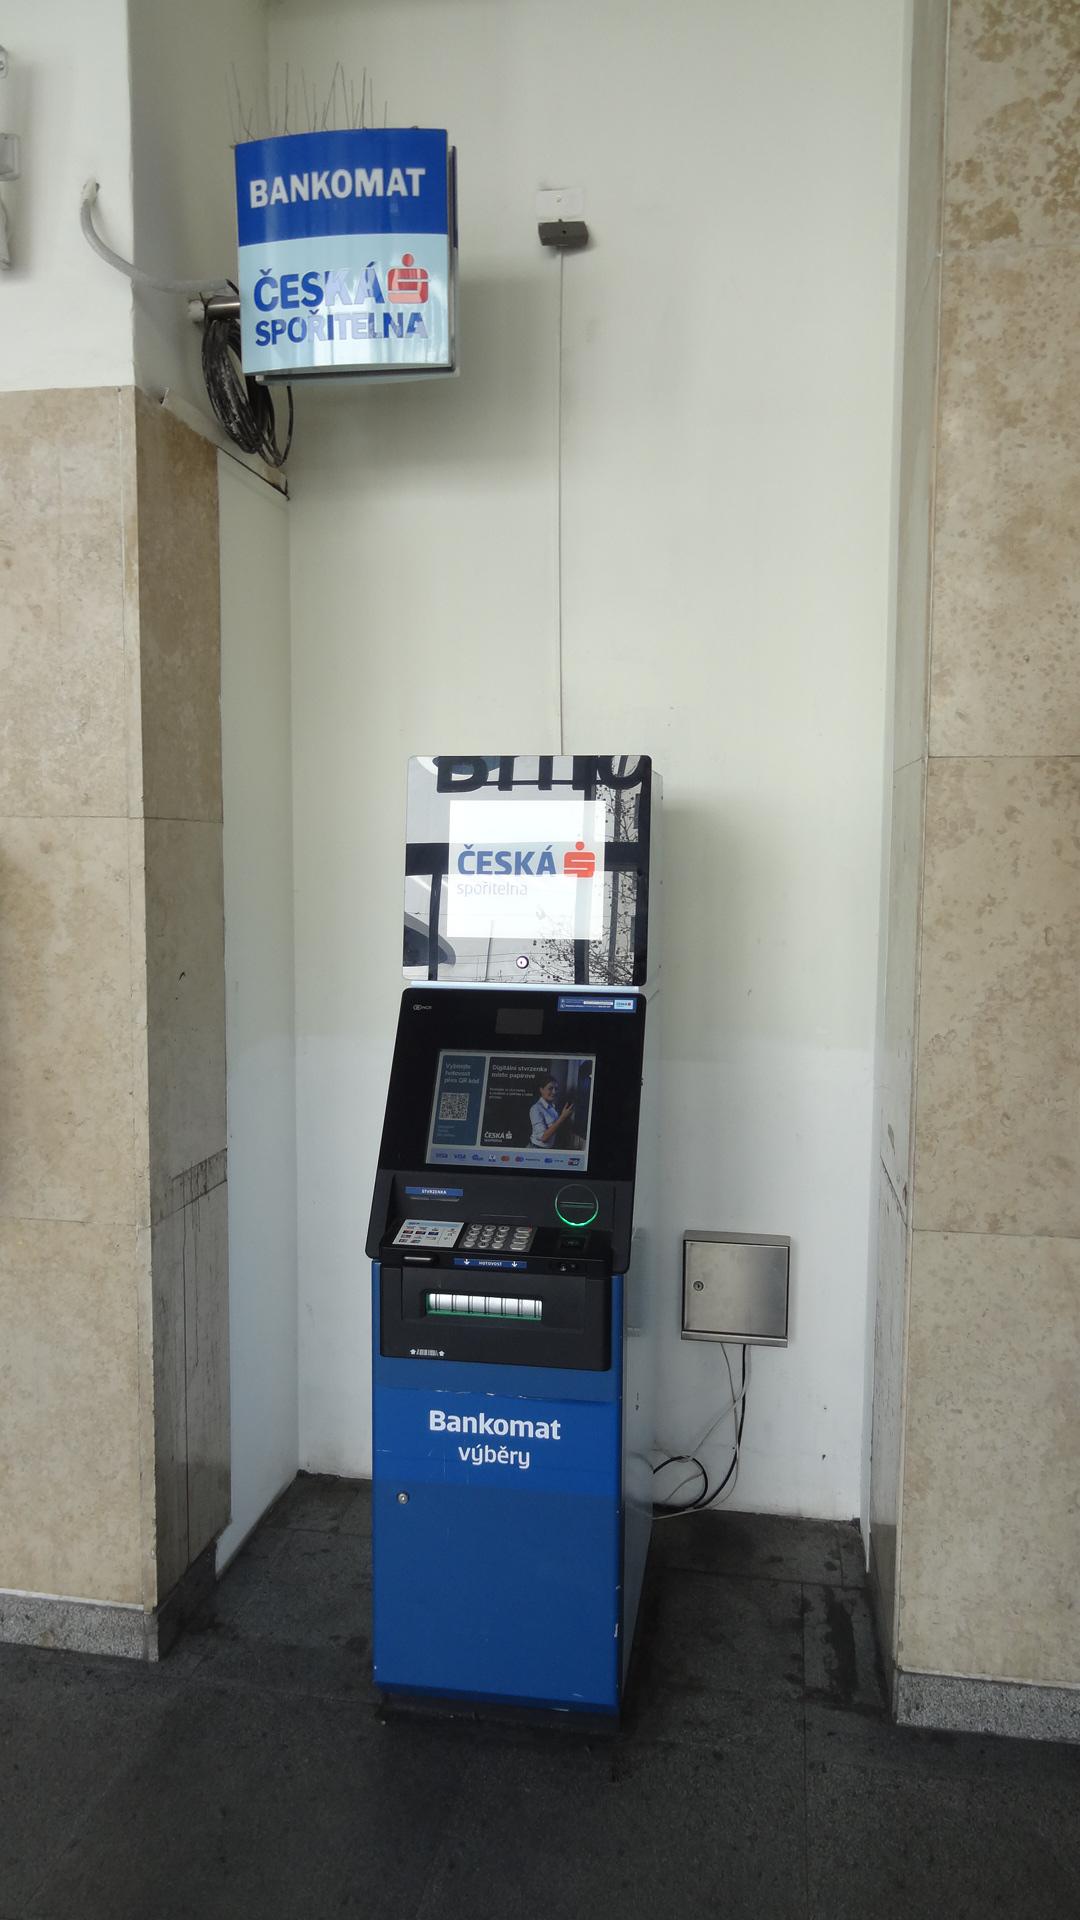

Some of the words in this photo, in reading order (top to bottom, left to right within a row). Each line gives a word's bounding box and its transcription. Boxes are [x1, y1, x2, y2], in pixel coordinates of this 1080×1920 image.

[250, 167, 426, 209] BANKOMAT
[253, 261, 386, 312] ČESKÁ
[255, 309, 429, 347] SPOŘITELNA
[457, 844, 557, 876] ČESKÁ
[456, 881, 528, 897] spořitelna
[484, 1131, 505, 1139] ČESKÁ
[429, 1409, 561, 1440] Bankomat
[458, 1443, 530, 1469] výběry
